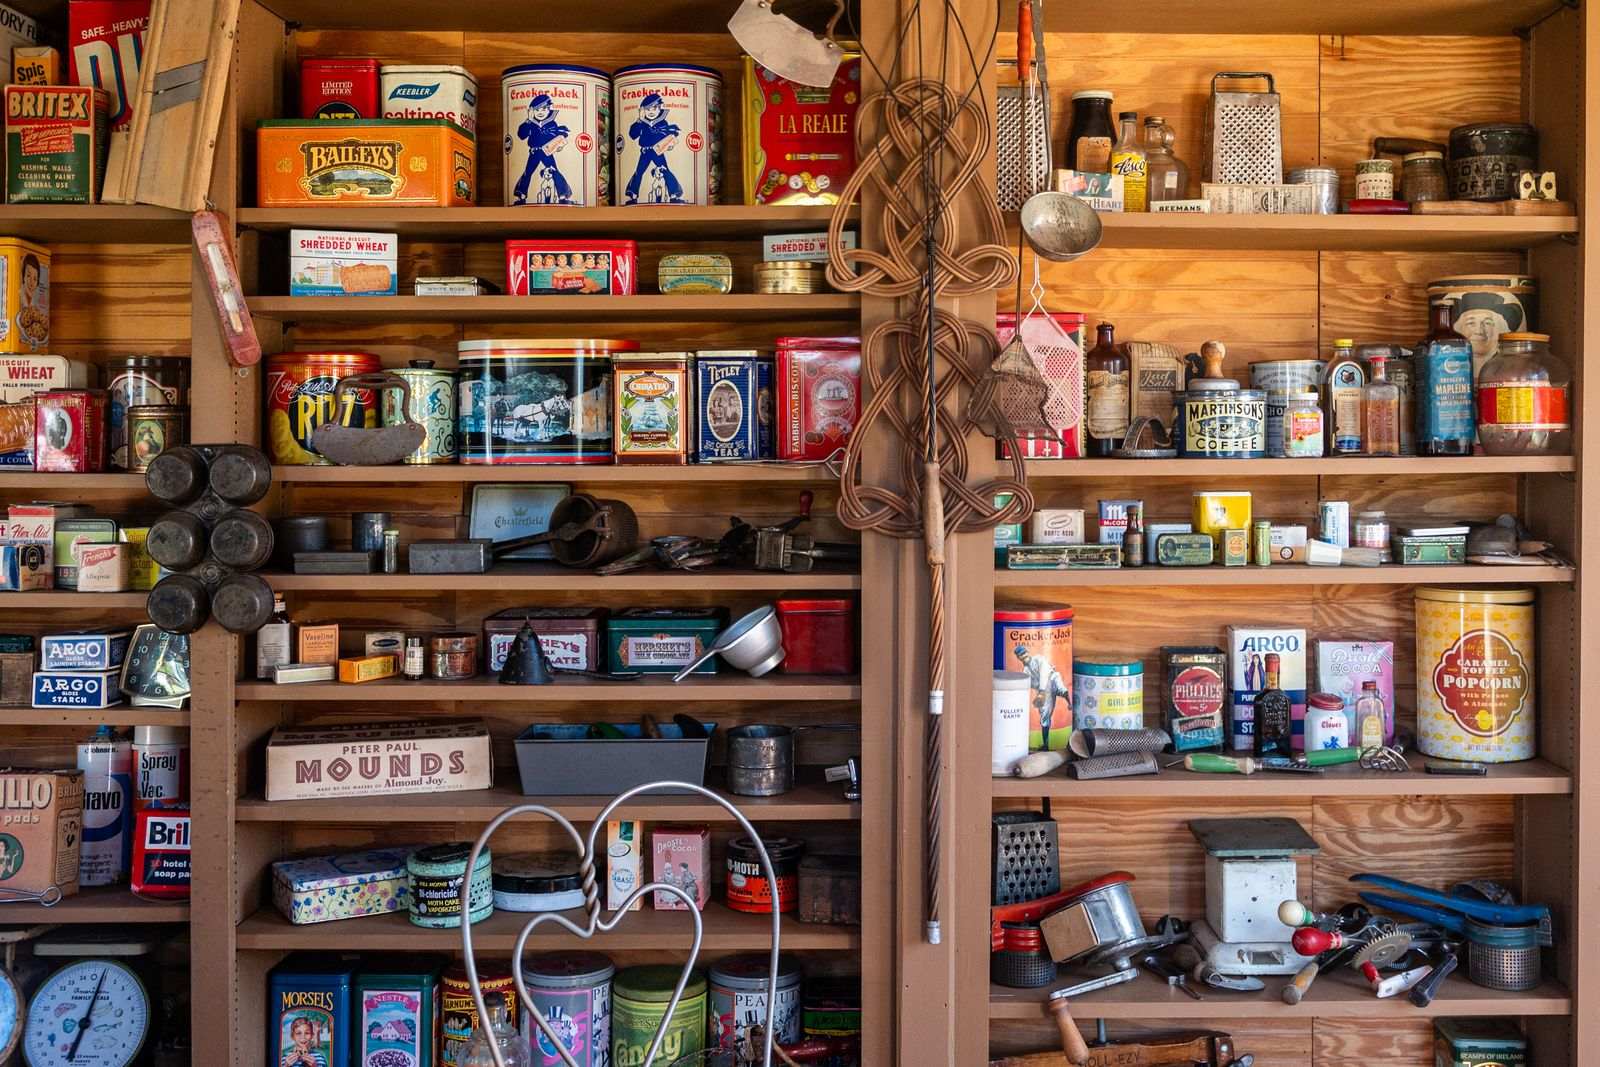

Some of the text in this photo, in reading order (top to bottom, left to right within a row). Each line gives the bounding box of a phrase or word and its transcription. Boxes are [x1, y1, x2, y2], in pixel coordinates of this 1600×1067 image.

[16, 62, 45, 82] Spic
[322, 81, 353, 89] LIMITED
[322, 88, 353, 96] EDITION
[510, 87, 579, 100] Cracker Jack
[621, 86, 689, 100] Cracker Jack
[8, 92, 88, 120] BRITEX
[779, 113, 848, 134] LA REALE
[577, 138, 592, 148] toy
[688, 136, 703, 147] toy
[309, 144, 394, 173] BAILEYS
[300, 239, 389, 252] SHREDDED WHEAT
[771, 242, 815, 253] SHREDDED
[8, 367, 55, 380] WHEAT
[708, 366, 741, 385] TETLEY
[1189, 402, 1264, 422] MARTINSON'S
[1195, 437, 1257, 450] COFFEE
[713, 449, 739, 457] TEAS
[494, 515, 544, 529] Chesterfield
[304, 632, 334, 641] Vaseline
[1010, 628, 1072, 641] Cracker Jack
[138, 645, 148, 654] 10
[1240, 635, 1300, 652] ARGO
[49, 642, 101, 659] ARGO
[132, 658, 140, 666] 9
[1330, 663, 1382, 674] COCOA
[1456, 659, 1510, 667] CARAMEL
[1462, 666, 1506, 674] TOFFEE
[39, 678, 99, 694] ARGO
[1442, 674, 1521, 689] POPCORN
[155, 686, 162, 694] 6
[1174, 682, 1222, 699] PHILLIES
[342, 742, 419, 755] PETER PAUL
[142, 752, 177, 772] Spray
[295, 750, 466, 784] MOUNDS
[384, 776, 424, 789] Almond
[141, 782, 164, 799] Vac
[82, 790, 121, 811] ravo
[4, 813, 40, 827] pads
[163, 860, 188, 868] hotel
[154, 870, 176, 880] soap
[281, 991, 334, 1012] MORSELS
